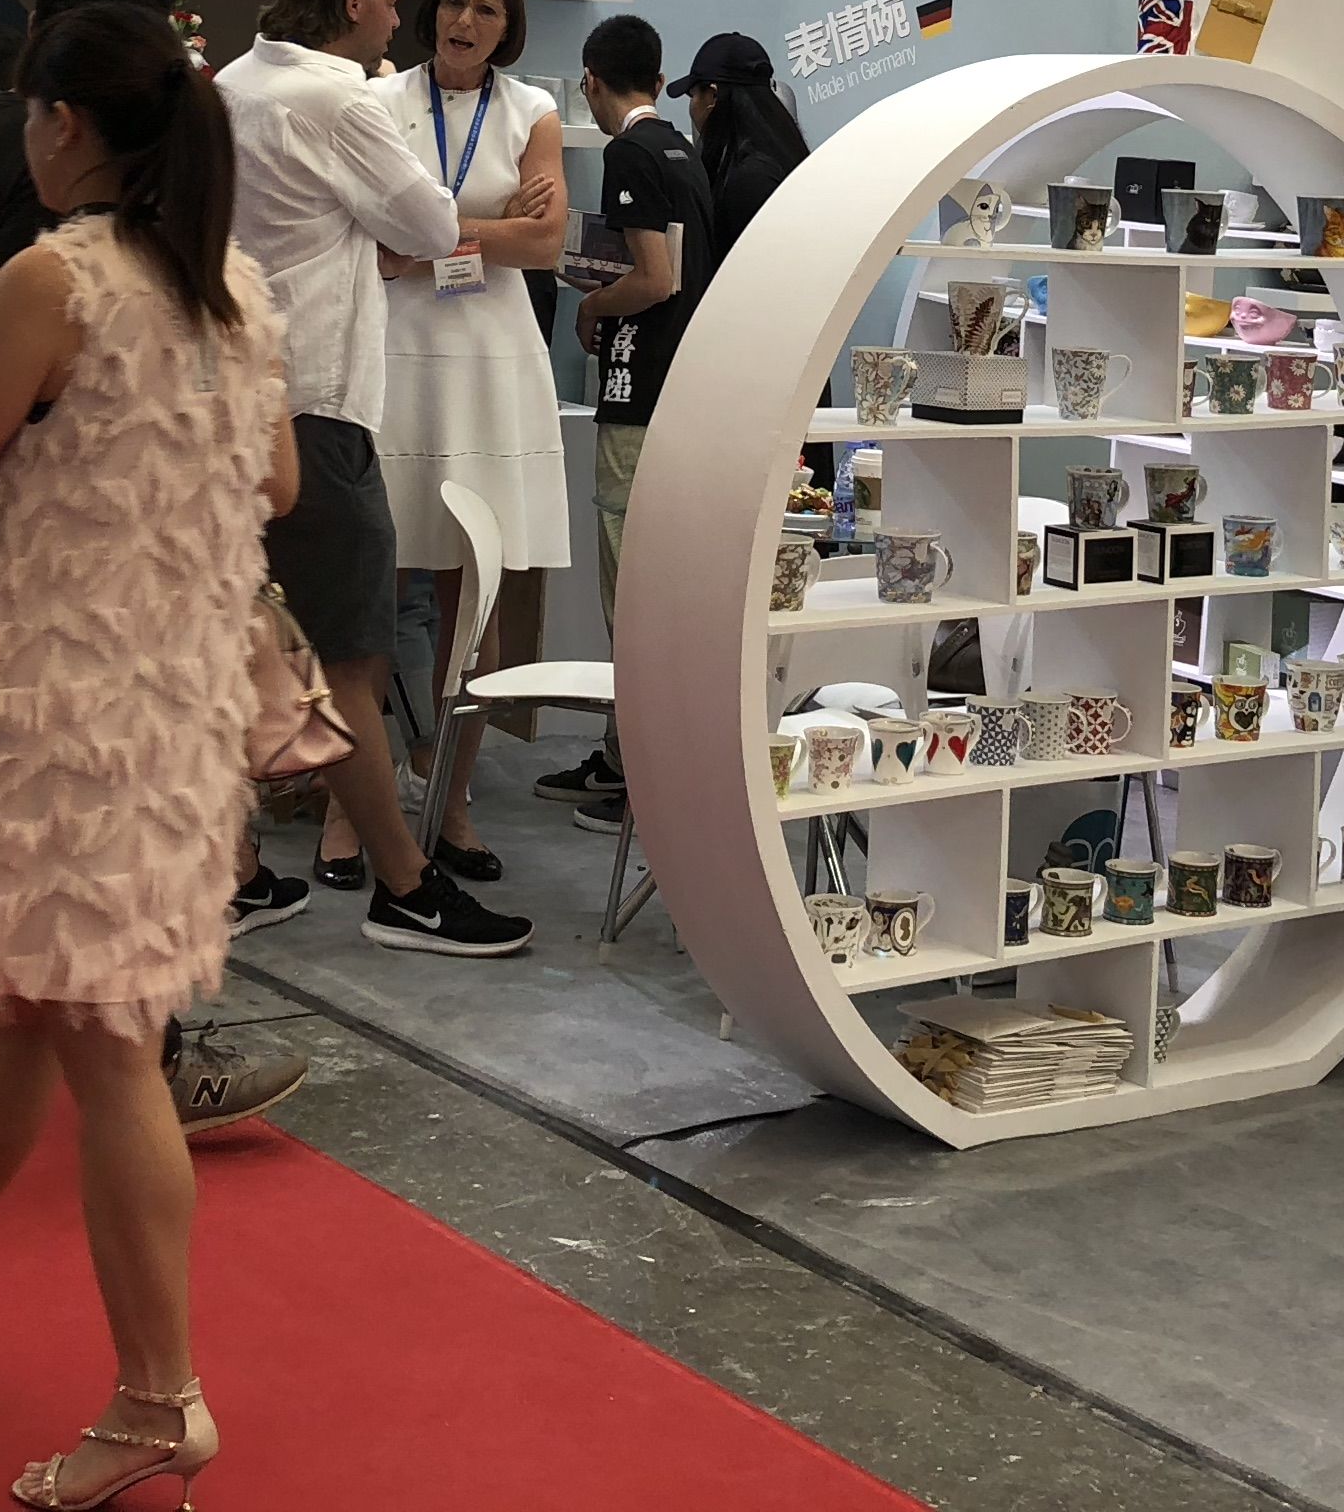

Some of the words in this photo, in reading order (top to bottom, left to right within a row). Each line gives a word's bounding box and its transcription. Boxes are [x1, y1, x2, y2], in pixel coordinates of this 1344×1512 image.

[807, 76, 846, 105] Made
[847, 69, 859, 85] in
[860, 45, 916, 81] Germany
[190, 1075, 231, 1107] N
